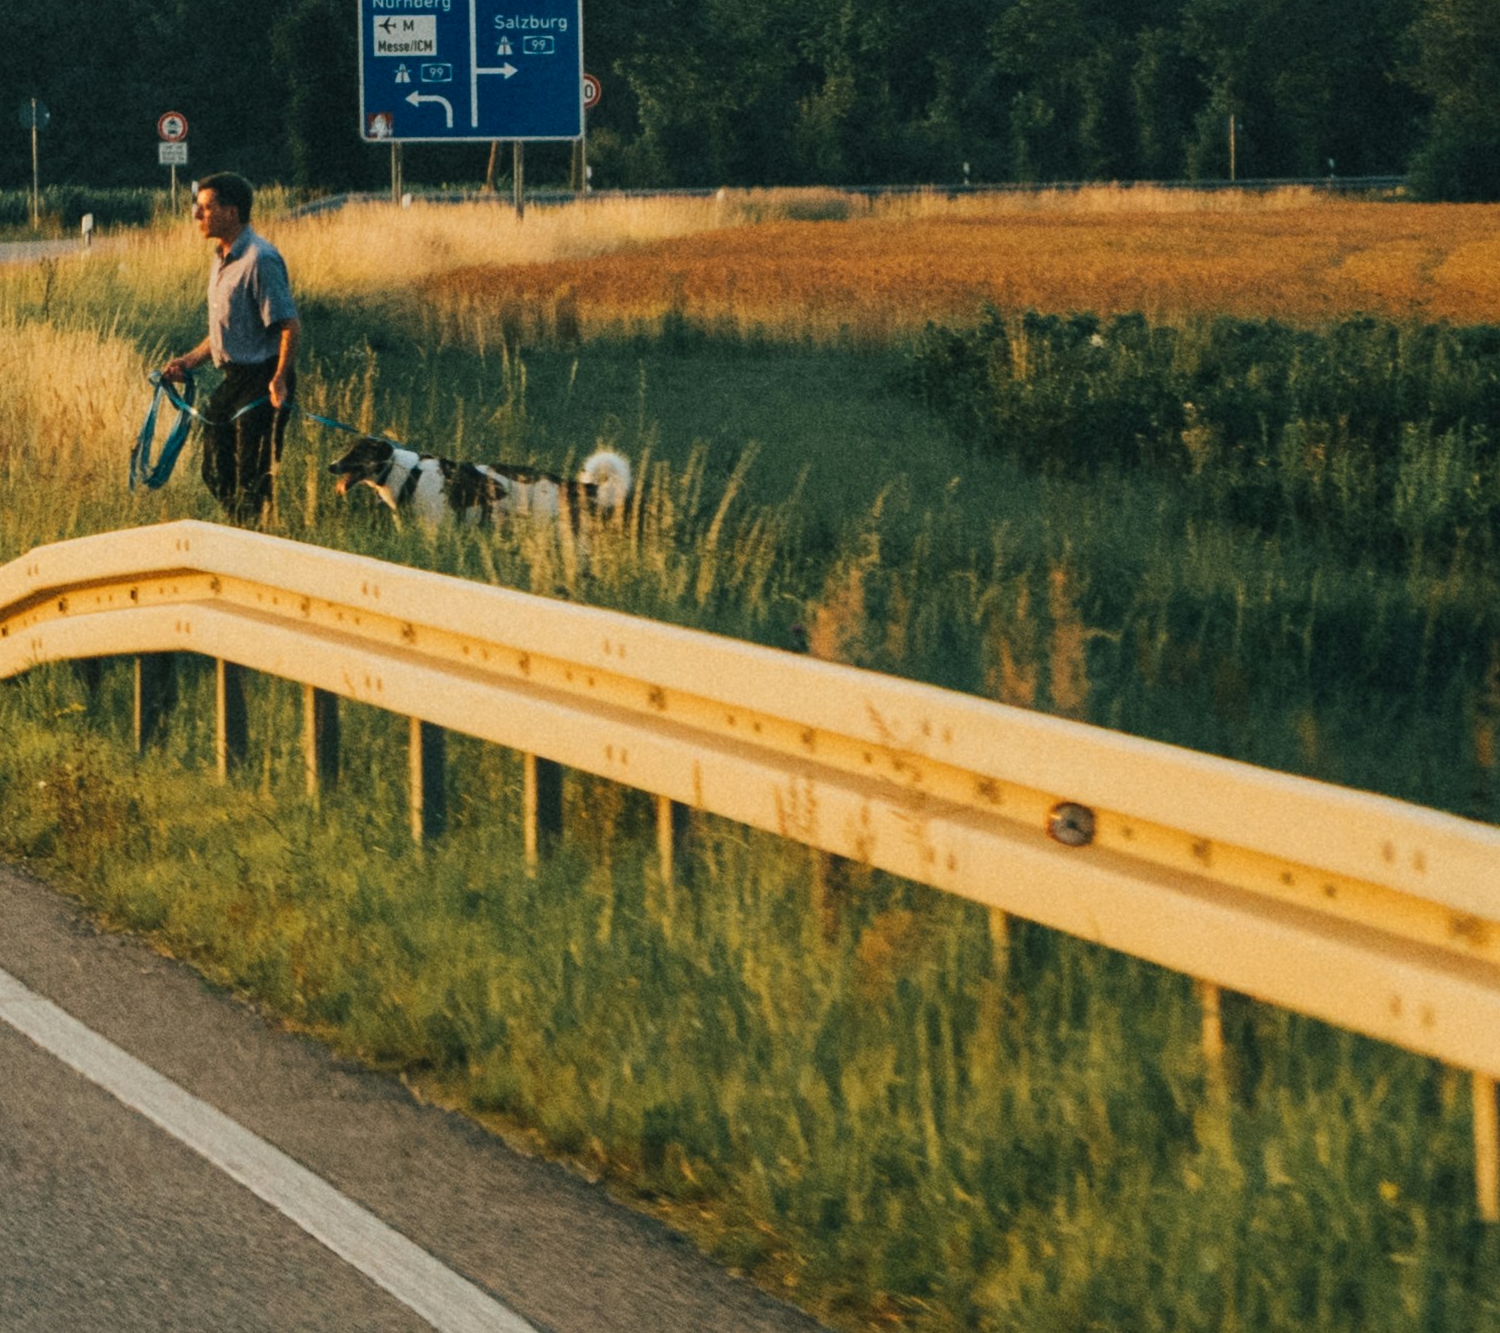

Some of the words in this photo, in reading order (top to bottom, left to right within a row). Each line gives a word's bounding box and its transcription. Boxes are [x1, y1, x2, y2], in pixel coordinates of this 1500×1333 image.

[402, 19, 414, 32] M
[494, 15, 568, 32] Salzburg
[378, 40, 433, 53] Messe/ICM
[531, 39, 546, 51] 99
[429, 67, 444, 78] 99
[584, 84, 594, 99] 0
